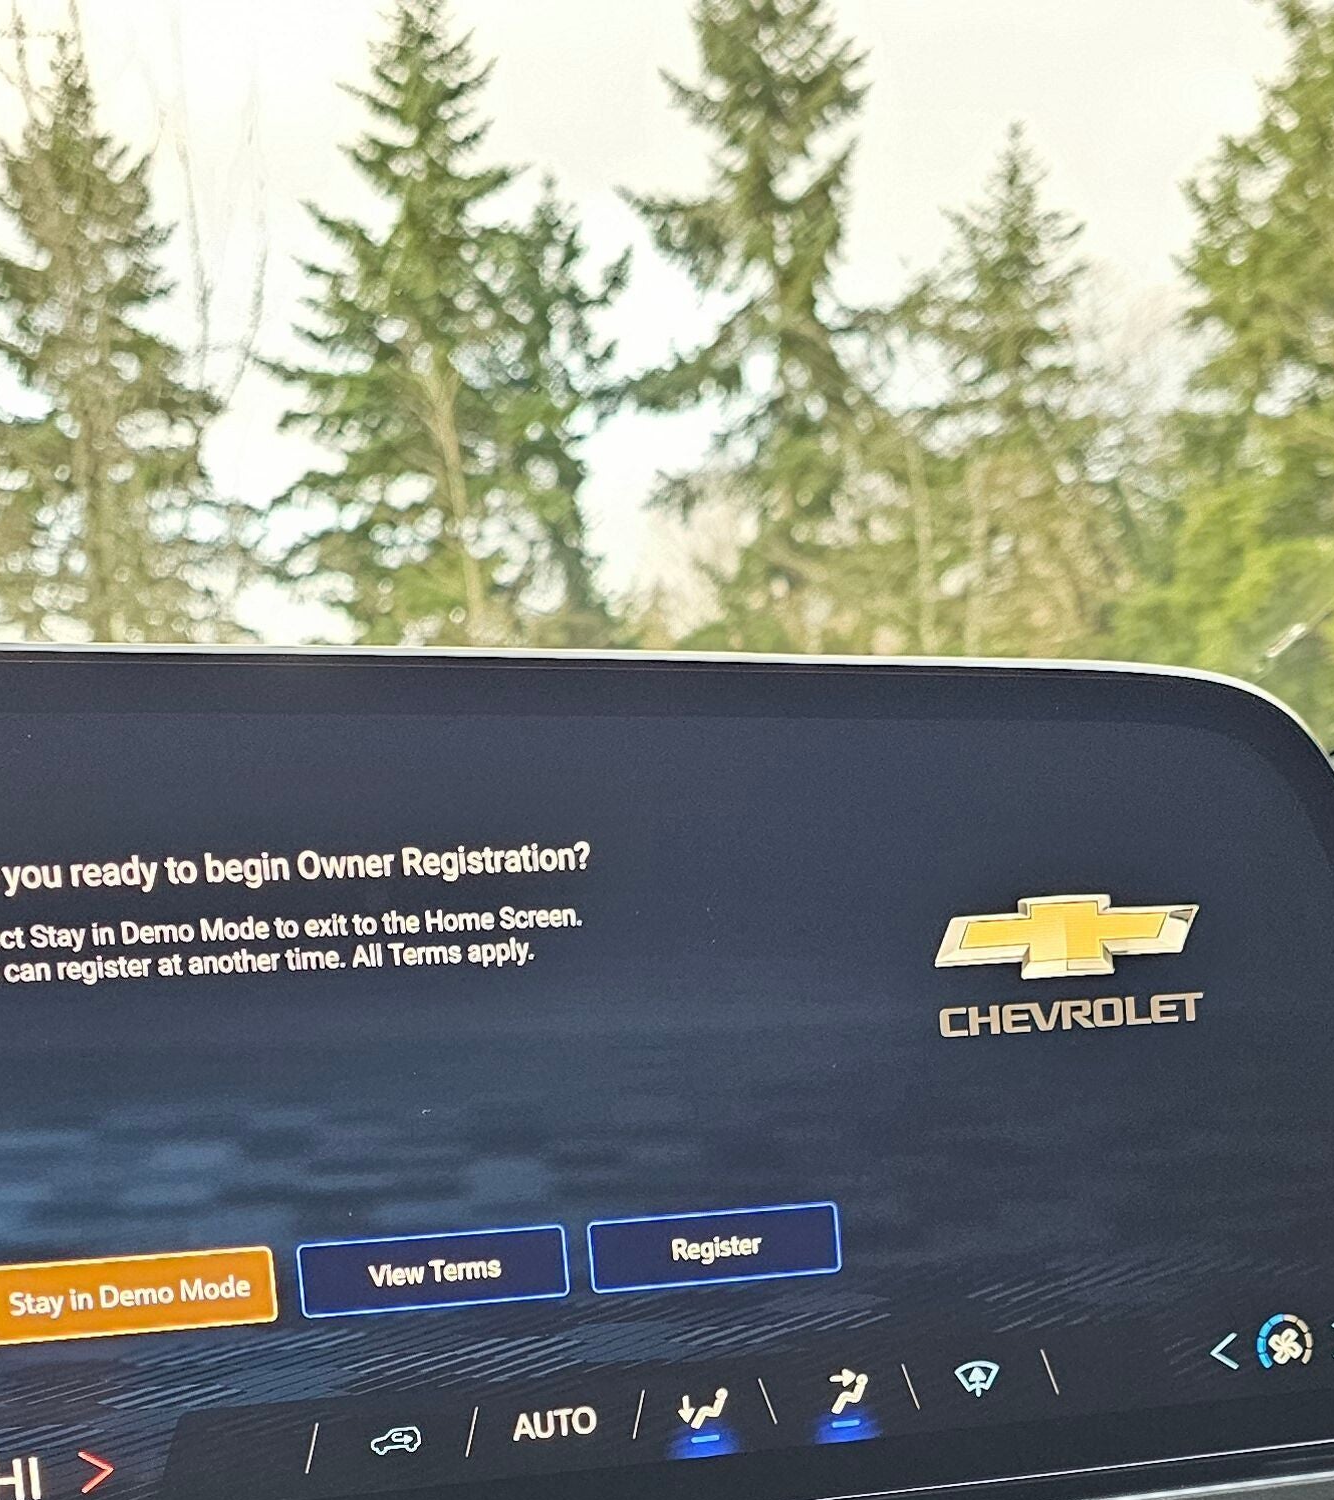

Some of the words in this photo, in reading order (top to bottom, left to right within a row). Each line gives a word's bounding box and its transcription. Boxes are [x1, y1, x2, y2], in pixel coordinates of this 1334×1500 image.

[0, 864, 63, 898] you
[69, 854, 159, 893] ready
[163, 856, 198, 885] to
[203, 851, 291, 889] begin
[296, 849, 396, 880] Owner
[401, 840, 591, 882] Registration?
[29, 923, 87, 953] Stay
[91, 921, 116, 947] in
[120, 920, 195, 945] Demo
[199, 915, 270, 942] Mode
[272, 916, 300, 939] to
[303, 912, 349, 938] exit
[351, 913, 378, 937] to
[380, 909, 421, 935] the
[424, 908, 495, 933] Home
[498, 905, 583, 930] Screen.
[3, 962, 52, 984] can
[56, 954, 153, 986] register
[157, 953, 184, 977] at
[187, 947, 281, 976] another
[283, 946, 347, 972] time.
[352, 942, 384, 969] All
[386, 942, 463, 967] Terms
[467, 936, 535, 968] apply.
[938, 991, 1205, 1038] CHEVROLET
[367, 1263, 426, 1288] View
[427, 1258, 502, 1283] Terms
[671, 1235, 763, 1265] Register
[8, 1291, 64, 1319] Stay
[68, 1288, 94, 1311] in
[98, 1284, 175, 1309] Demo
[179, 1273, 251, 1302] Mode
[512, 1405, 598, 1442] AUTO
